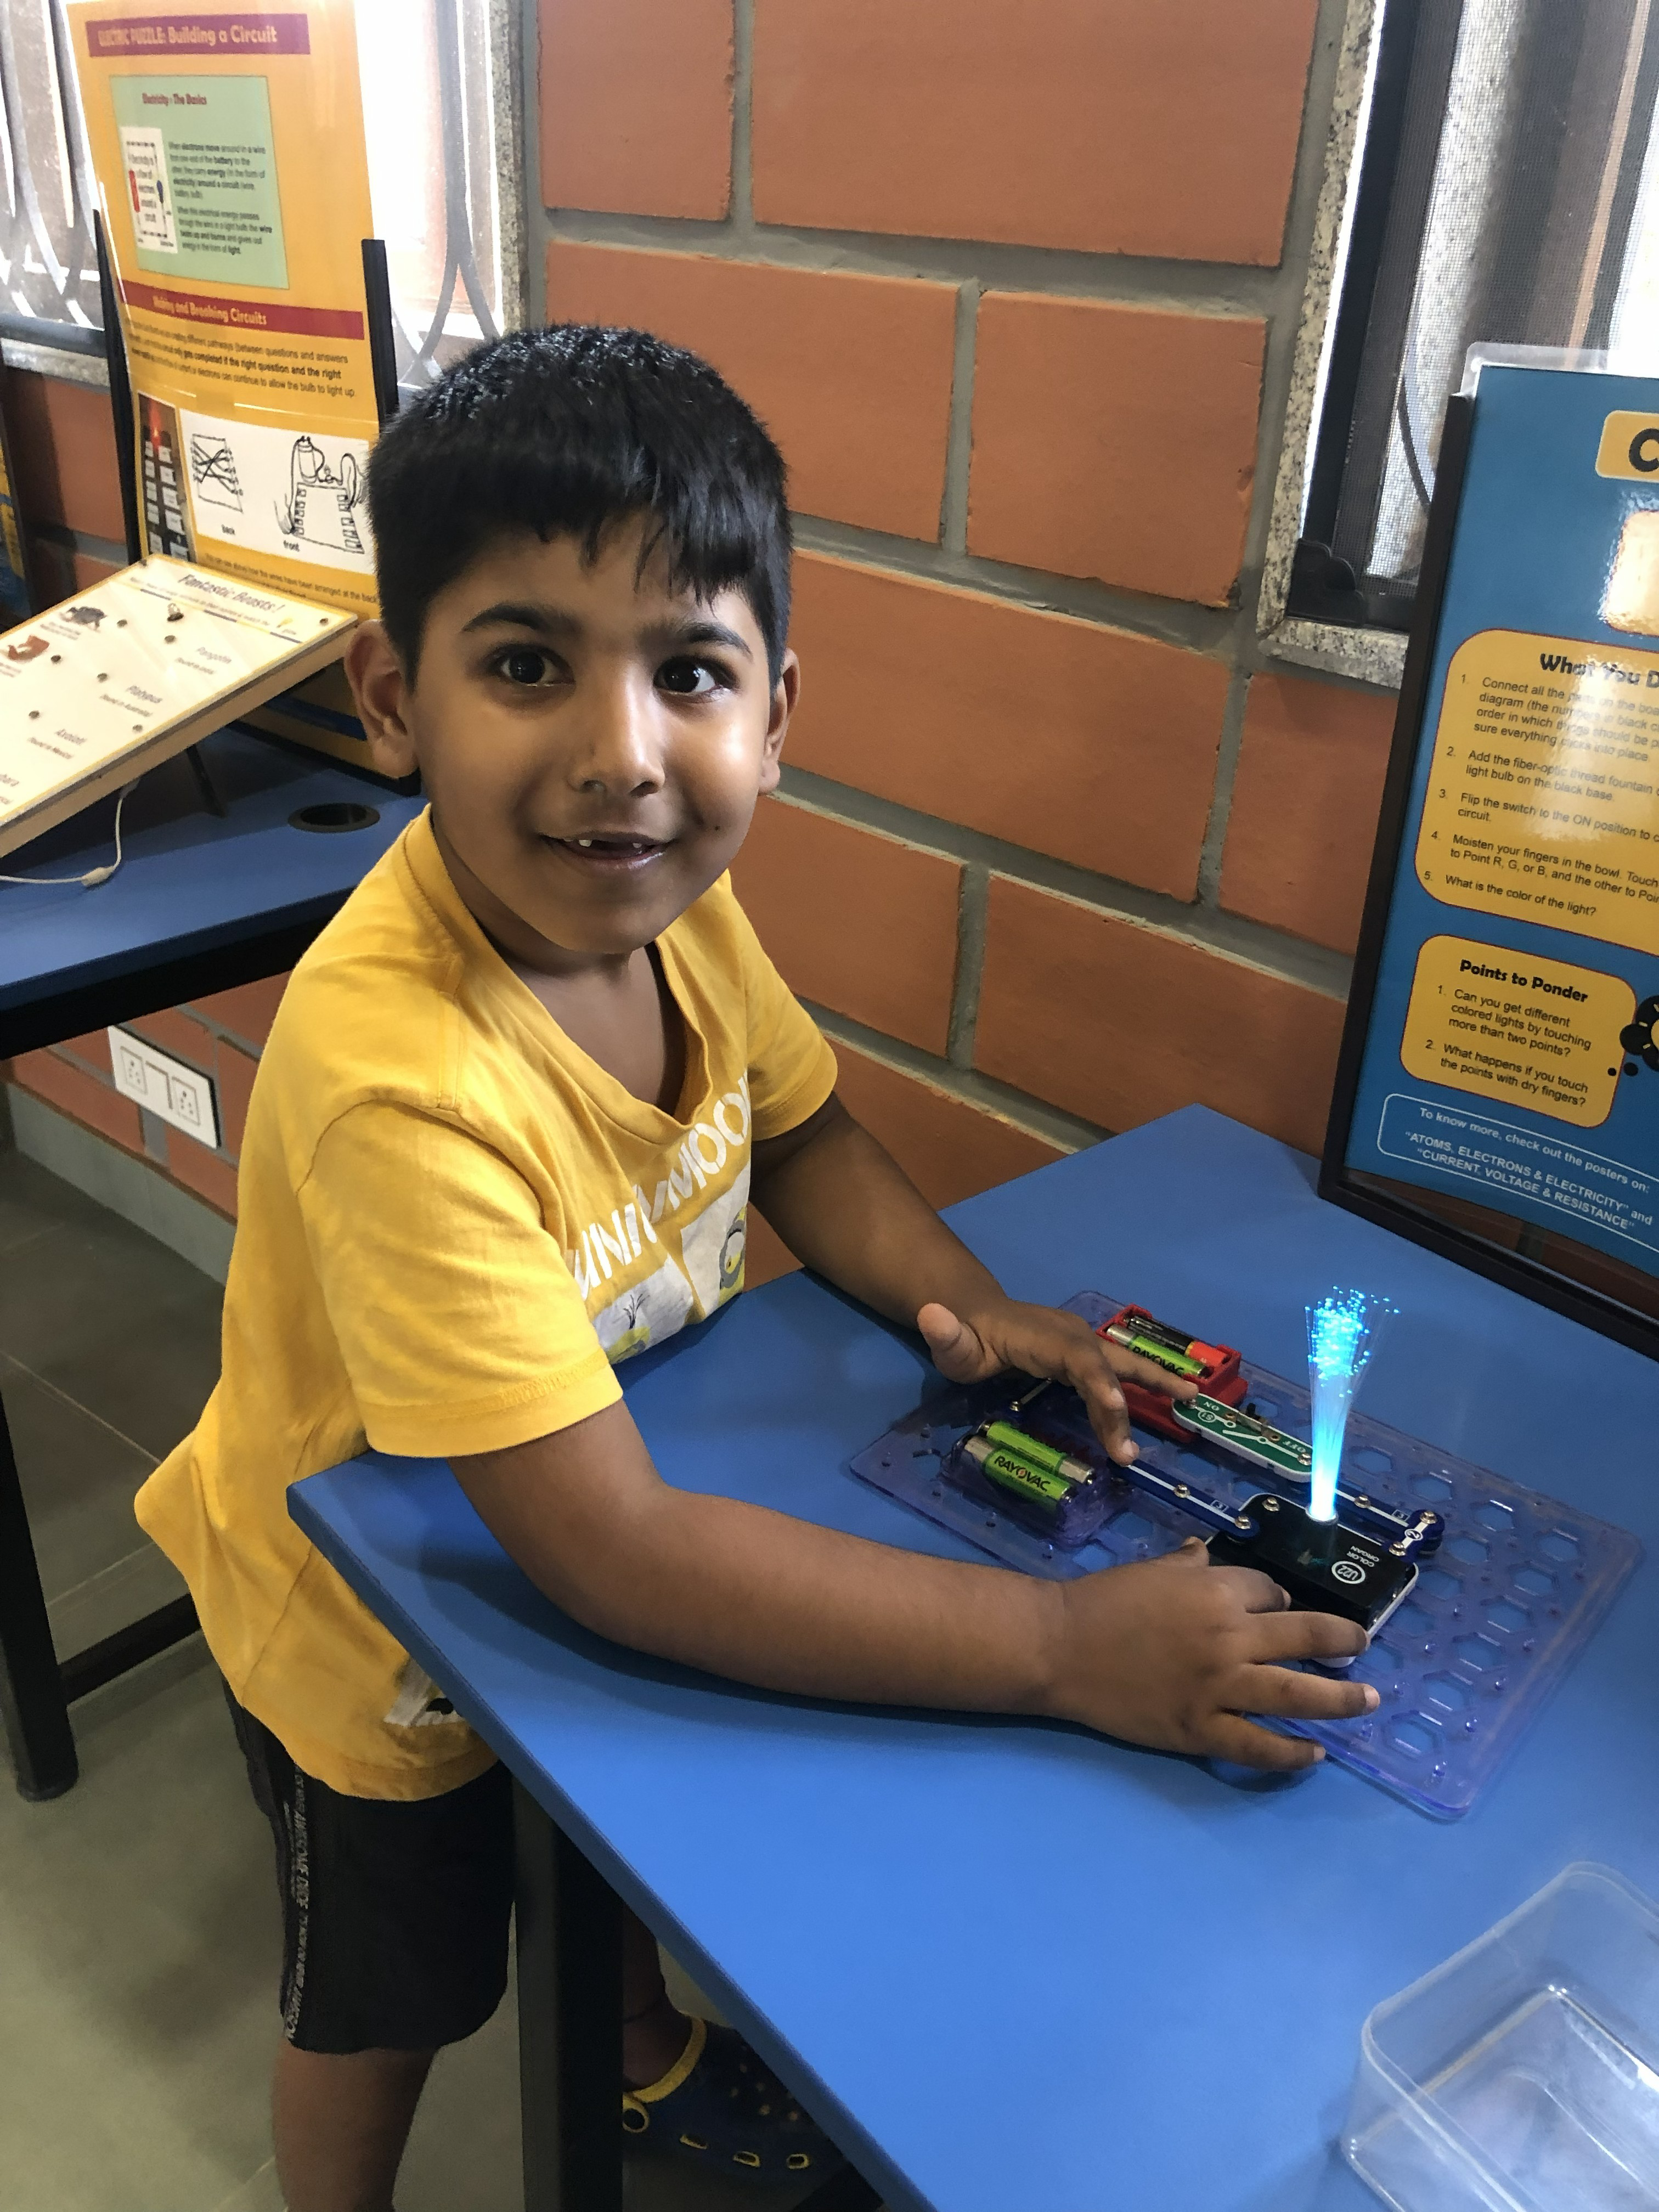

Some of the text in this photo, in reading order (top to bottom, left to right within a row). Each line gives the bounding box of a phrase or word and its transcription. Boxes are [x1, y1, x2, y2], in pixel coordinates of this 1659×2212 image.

[168, 25, 216, 46] Building
[219, 32, 228, 43] a
[230, 25, 278, 43] Circuit
[230, 307, 267, 325] Circuits
[291, 366, 305, 375] and
[322, 369, 341, 380] right
[1540, 653, 1595, 677] What
[1601, 662, 1641, 685] You
[1479, 692, 1523, 708] diagram
[1527, 699, 1549, 712] (the
[1617, 714, 1647, 730] black
[1482, 677, 1528, 693] Connect
[1531, 686, 1544, 696] all
[1547, 687, 1565, 699] the
[1617, 698, 1635, 711] the
[1474, 723, 1497, 734] sure
[1500, 727, 1557, 747] everything
[1593, 743, 1616, 755] into
[1618, 747, 1649, 761] place
[1476, 708, 1505, 720] order
[1508, 712, 1518, 723] in
[1521, 714, 1553, 729] which
[1593, 727, 1631, 742] should
[1634, 733, 1648, 745] be
[1465, 764, 1489, 778] light
[1491, 769, 1514, 782] bulb
[1517, 775, 1532, 785] on
[1534, 777, 1551, 789] the
[1554, 780, 1583, 795] black
[1468, 750, 1491, 763] Add
[1493, 754, 1510, 766] the
[1513, 757, 1567, 775] fiber-optic
[1570, 768, 1606, 784] thread
[1609, 775, 1654, 794] fountain
[1458, 807, 1492, 822] circuit.
[1460, 792, 1480, 806] Flip
[1483, 797, 1500, 809] the
[1502, 802, 1537, 816] switch
[1539, 808, 1550, 819] to
[1552, 810, 1570, 822] the
[1572, 814, 1592, 827] ON
[1593, 820, 1637, 837] position
[1639, 829, 1651, 840] to
[1450, 848, 1460, 858] to
[1463, 850, 1491, 865] Point
[1493, 856, 1504, 869] R,
[1508, 859, 1520, 872] G,
[1523, 864, 1535, 873] or
[1537, 865, 1548, 878] B,
[1551, 870, 1572, 882] and
[1574, 874, 1592, 887] the
[1594, 880, 1623, 894] other
[1625, 886, 1636, 897] to
[1453, 834, 1494, 850] Moisten
[1496, 844, 1521, 856] your
[1523, 848, 1559, 864] fingers
[1561, 856, 1572, 867] in
[1575, 859, 1592, 872] the
[1594, 864, 1622, 879] bowl.
[1627, 870, 1658, 888] Touch
[1445, 874, 1473, 889] What
[1475, 881, 1485, 891] is
[1487, 883, 1503, 895] the
[1506, 889, 1533, 901] color
[1534, 894, 1547, 904] of
[1548, 897, 1565, 909] the
[1567, 901, 1596, 916] light?
[1459, 959, 1589, 1003] Points to Ponder
[1454, 989, 1477, 1002] Can
[1480, 997, 1501, 1008] you
[1503, 1002, 1521, 1014] get
[1524, 1006, 1571, 1028] different
[1448, 1018, 1571, 1058] more than two points?
[1451, 1005, 1592, 1052] colored lights by touching
[1440, 1057, 1587, 1108] the points with dry fingers?
[1443, 1043, 1474, 1060] What
[1475, 1051, 1522, 1073] happens
[1525, 1064, 1534, 1075] if
[1534, 1069, 1555, 1084] you
[1558, 1075, 1589, 1094] touch
[1420, 1107, 1650, 1194] To know more, check out the posters on:
[1458, 1146, 1532, 1177] ELECTRONS
[1533, 1170, 1543, 1181] &
[1630, 1210, 1654, 1226] and
[1485, 1167, 1541, 1194] VOLTAGE
[1542, 1187, 1551, 1198] &
[1203, 1401, 1221, 1412] ON
[1282, 1440, 1307, 1453] OFF
[994, 1454, 1052, 1493] RAYOVAC
[1350, 1545, 1380, 1562] ORGAN
[1407, 1530, 1421, 1540] 2
[1336, 1564, 1359, 1581] U22
[1346, 1550, 1375, 1568] COLOR
